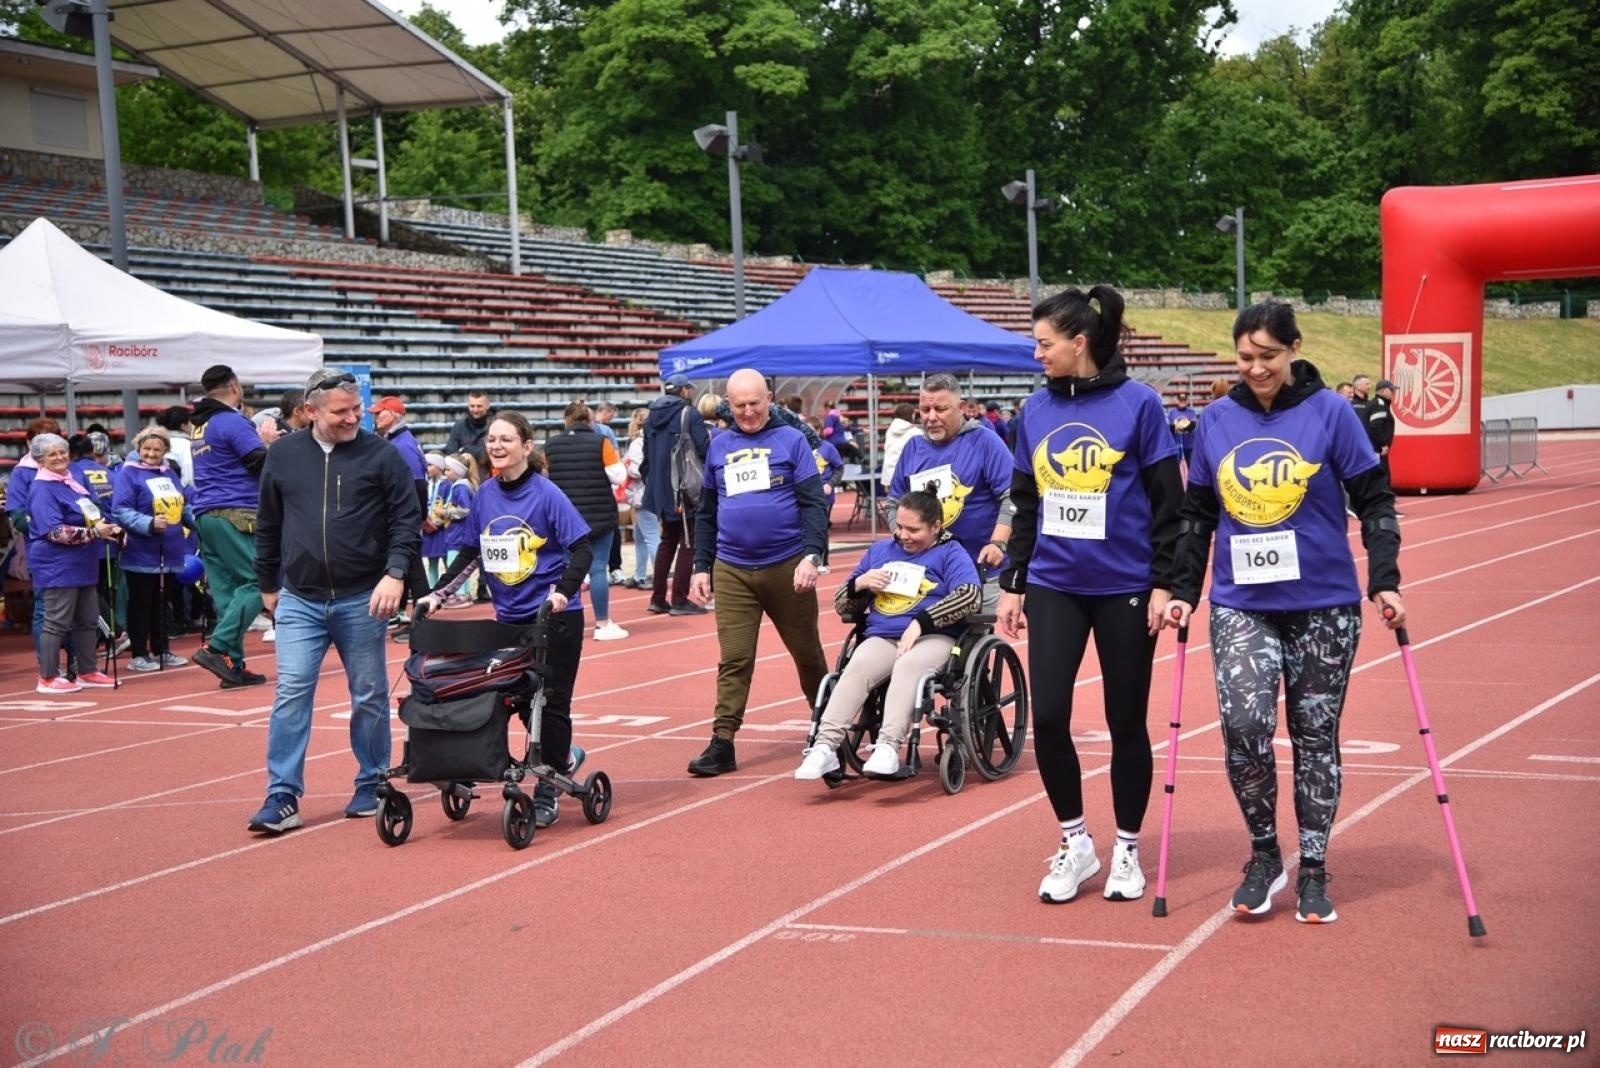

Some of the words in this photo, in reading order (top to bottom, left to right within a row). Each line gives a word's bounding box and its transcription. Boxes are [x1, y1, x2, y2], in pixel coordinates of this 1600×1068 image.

[109, 345, 158, 357] Racibórz
[736, 470, 757, 483] 102
[922, 479, 941, 491] 10
[1059, 507, 1088, 522] 107
[487, 548, 508, 560] 098
[1246, 550, 1279, 567] 160
